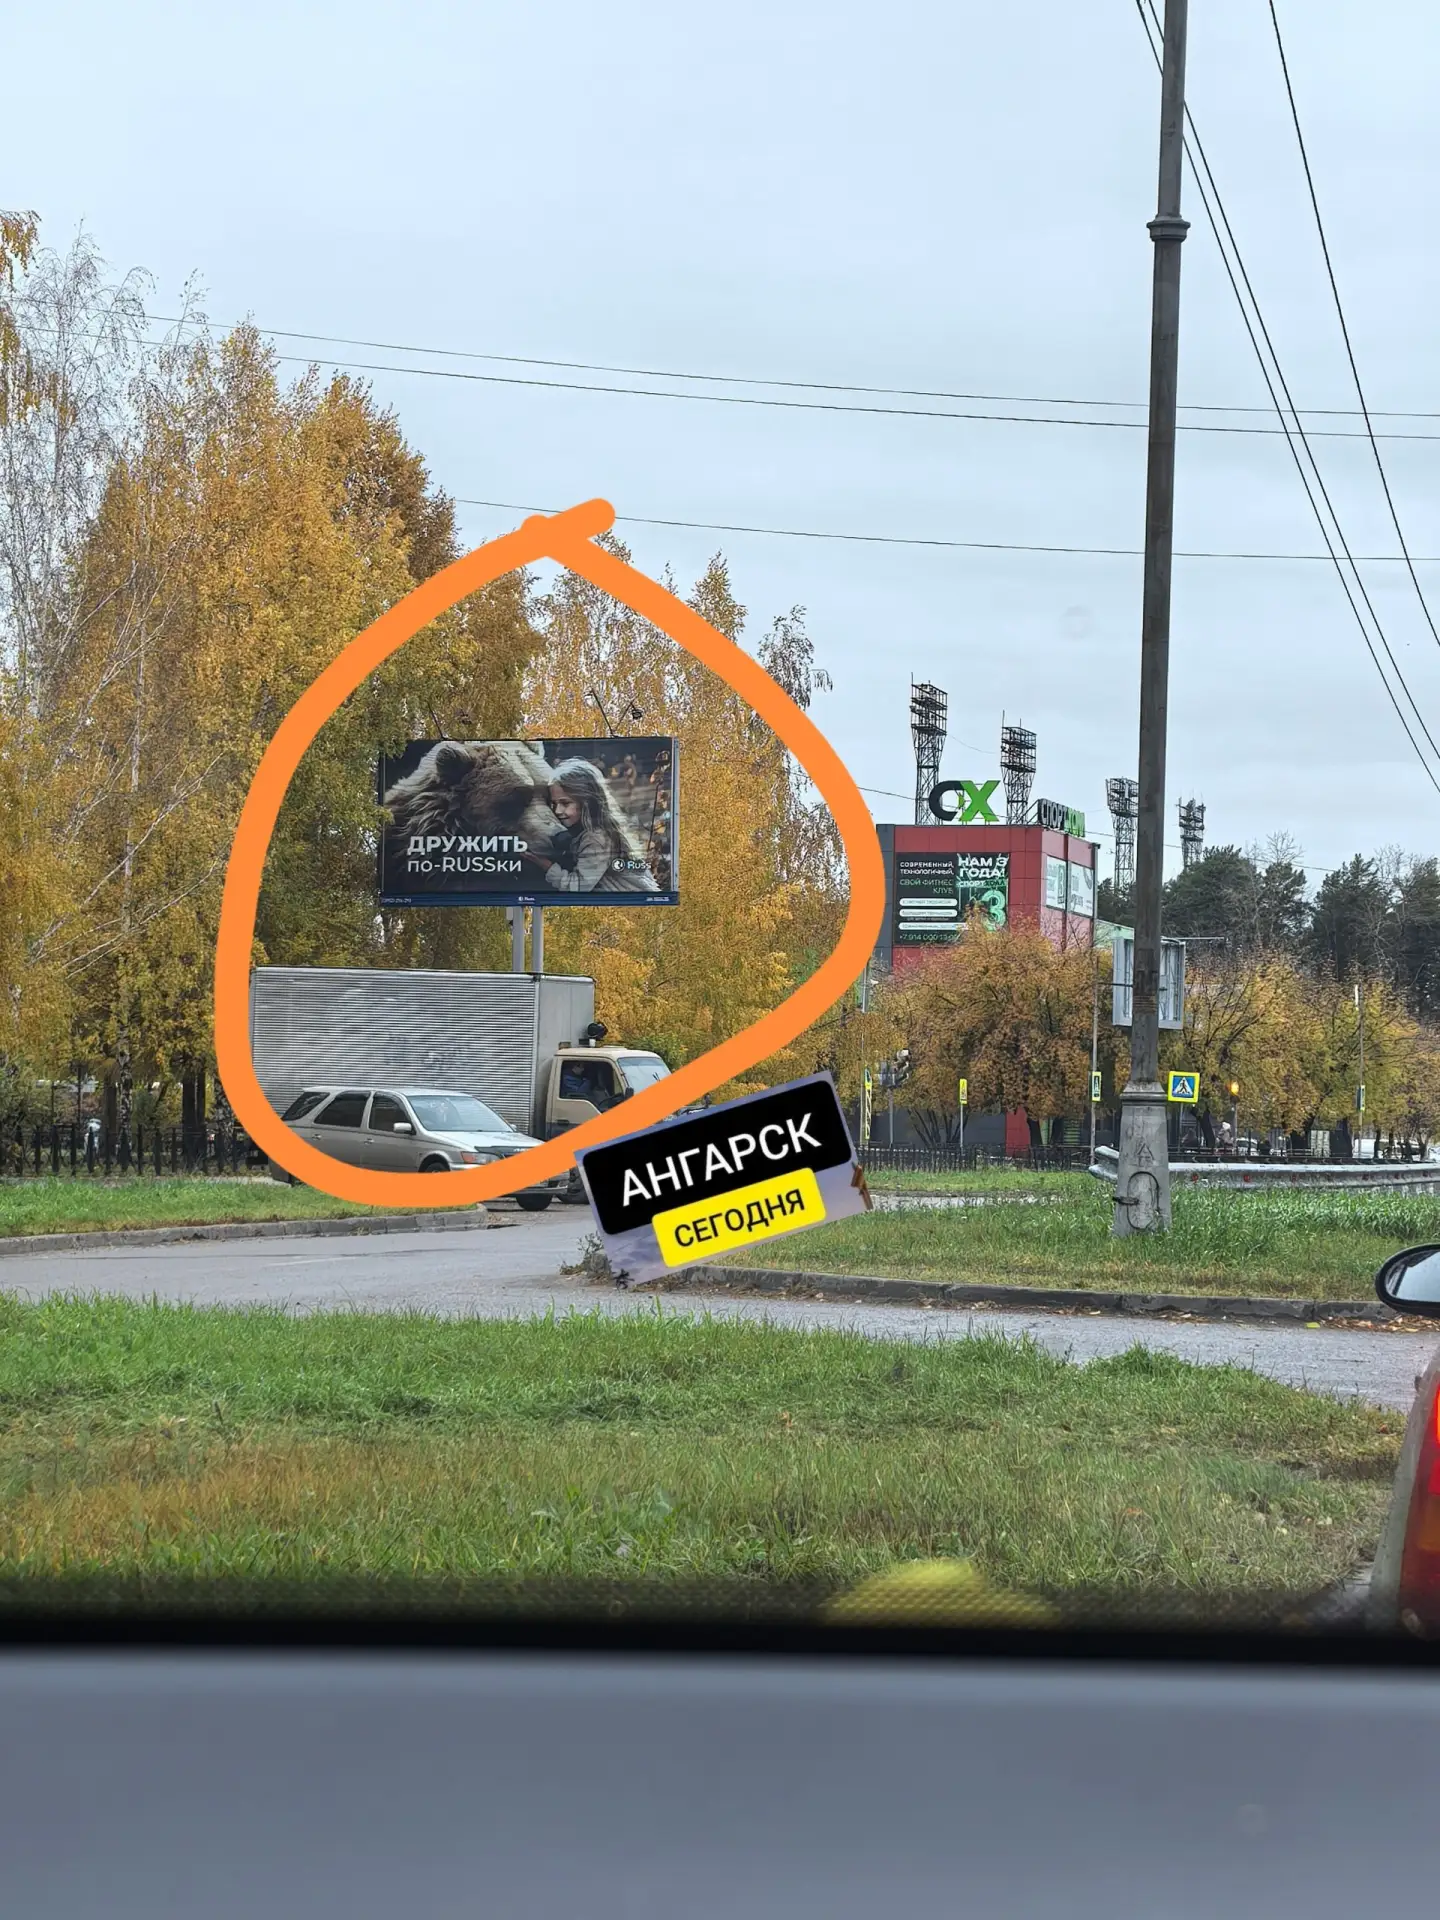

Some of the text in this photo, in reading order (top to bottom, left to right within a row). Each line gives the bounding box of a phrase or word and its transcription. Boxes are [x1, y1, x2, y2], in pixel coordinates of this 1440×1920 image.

[407, 835, 528, 857] ДРУЖИТЬ
[407, 857, 522, 873] по-RUSSки
[627, 860, 652, 870] Russ
[958, 857, 992, 867] НАМ
[959, 868, 1005, 879] ГОДА!
[899, 878, 921, 886] СВОЙ
